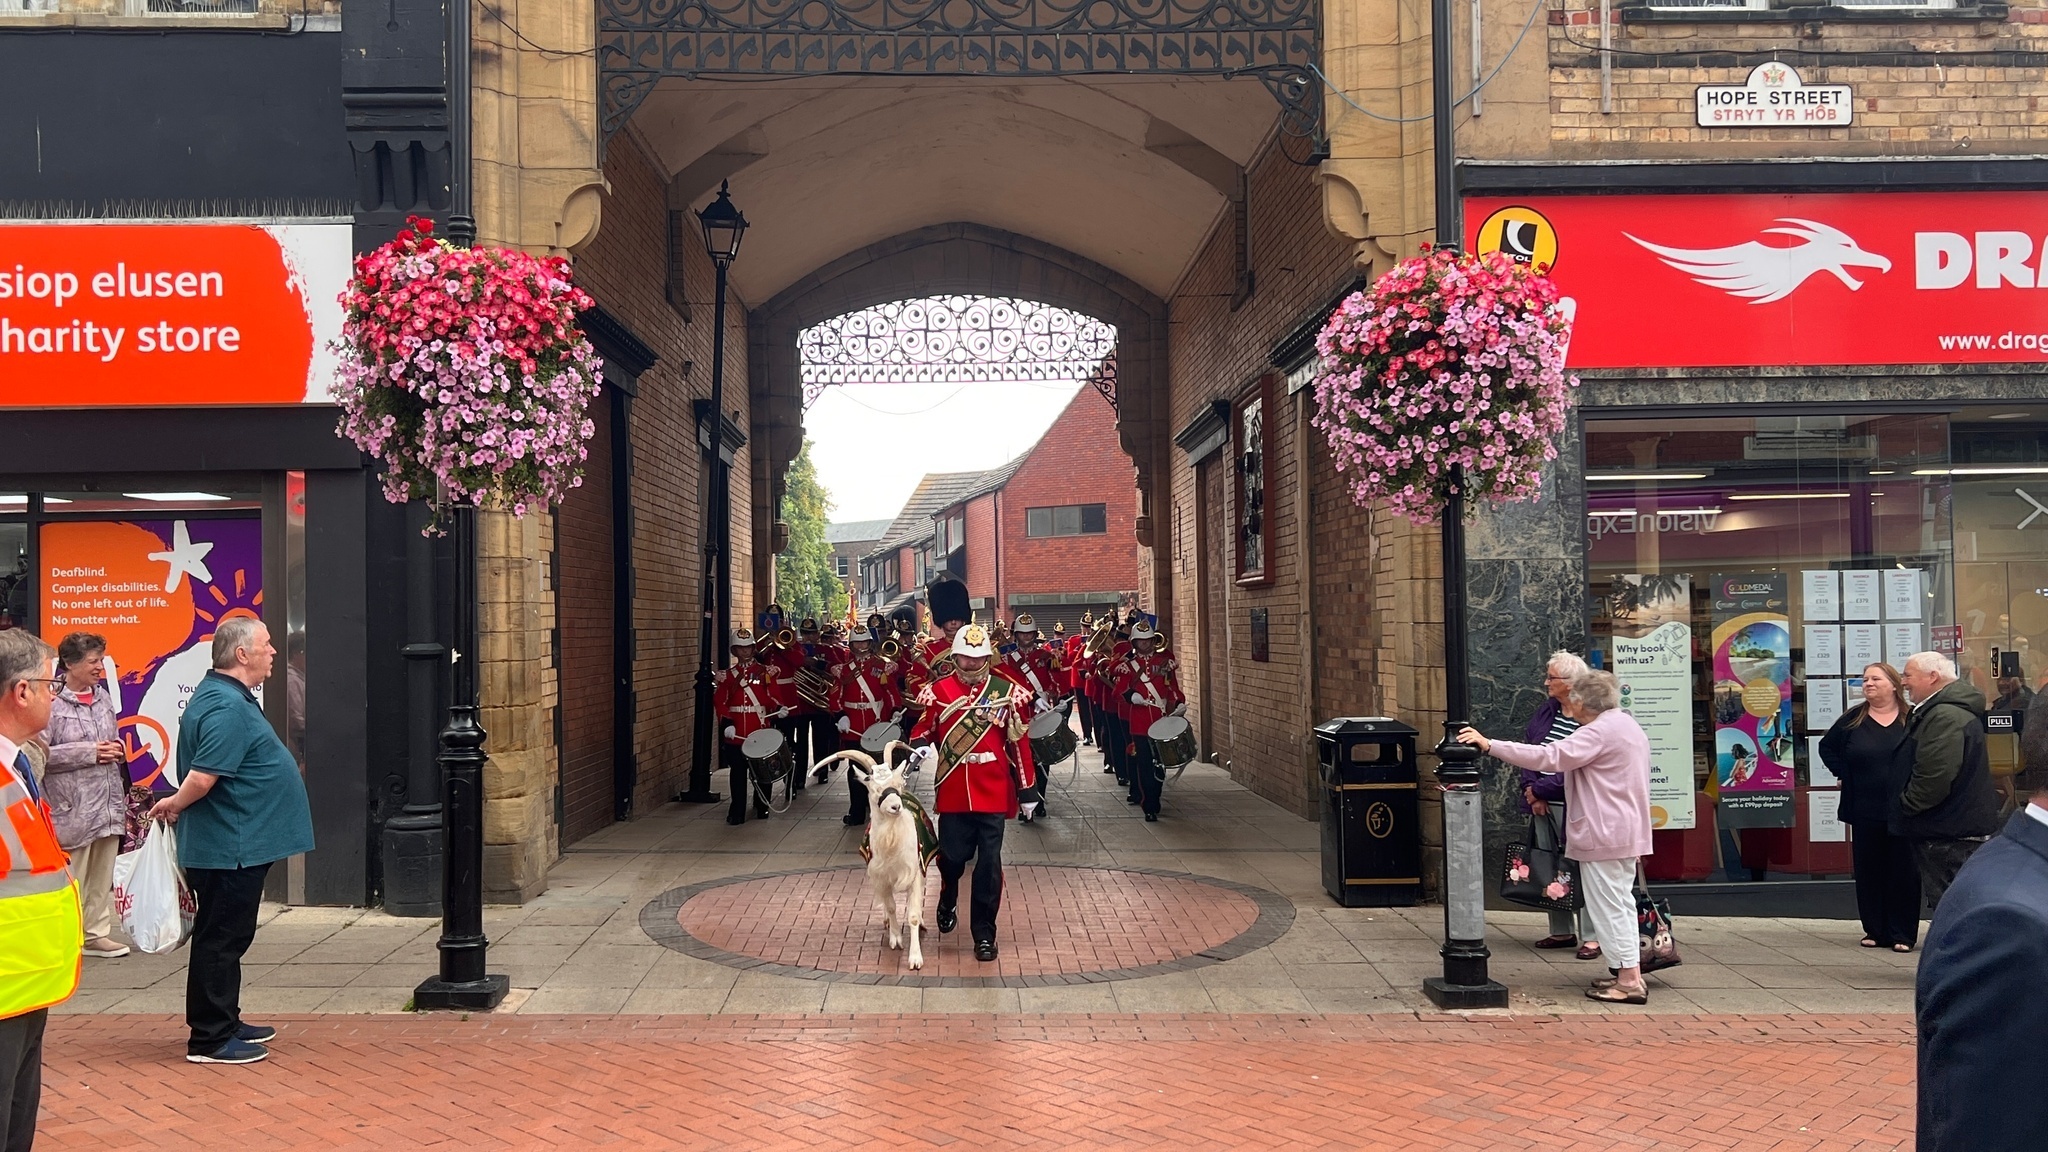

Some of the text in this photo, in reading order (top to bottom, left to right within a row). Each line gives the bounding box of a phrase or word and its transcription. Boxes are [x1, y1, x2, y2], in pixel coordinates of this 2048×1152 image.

[1707, 90, 1842, 105] HOPE STREET
[1714, 104, 1837, 121] STRYT YR HÔB
[1915, 230, 2048, 289] DR
[0, 262, 223, 307] siop elusen
[137, 321, 241, 352] store
[52, 567, 107, 577] Deafblind.
[52, 582, 161, 595] Complex disabilities.
[52, 600, 68, 609] No
[94, 598, 112, 608] left
[115, 599, 133, 608] out
[136, 597, 147, 607] of
[150, 597, 169, 607] life.
[52, 614, 141, 625] No matter what.
[1616, 644, 1665, 654] Why book
[1932, 638, 1962, 651] PEN
[1617, 656, 1654, 664] with us?
